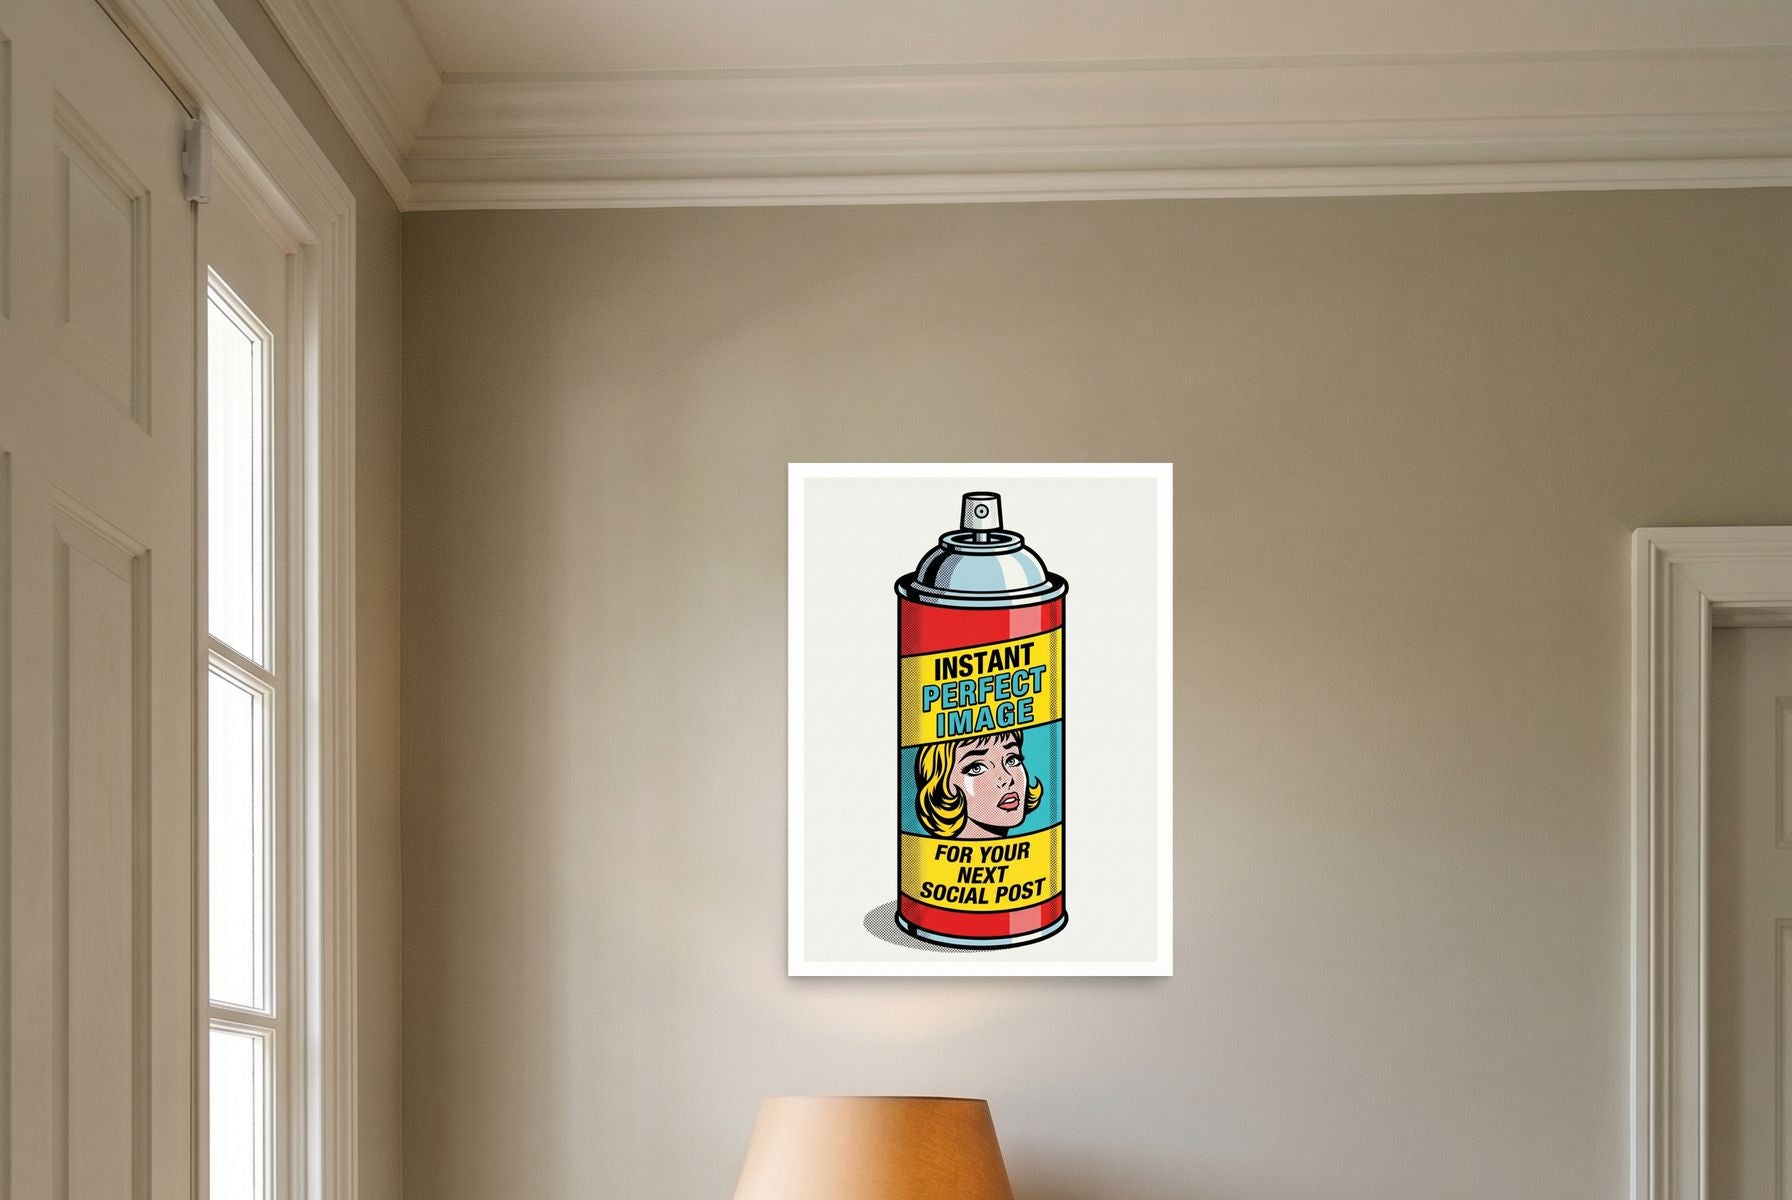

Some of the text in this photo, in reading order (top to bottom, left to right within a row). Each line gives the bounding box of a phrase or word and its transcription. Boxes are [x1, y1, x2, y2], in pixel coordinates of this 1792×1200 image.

[935, 642, 1034, 681] INSTANT
[922, 665, 1047, 712] PERFECT
[936, 697, 1034, 738] IMAGE
[934, 841, 1031, 864] FOR YOUR
[920, 877, 1046, 905] SOCIAL POST
[957, 865, 1009, 884] NEXT
